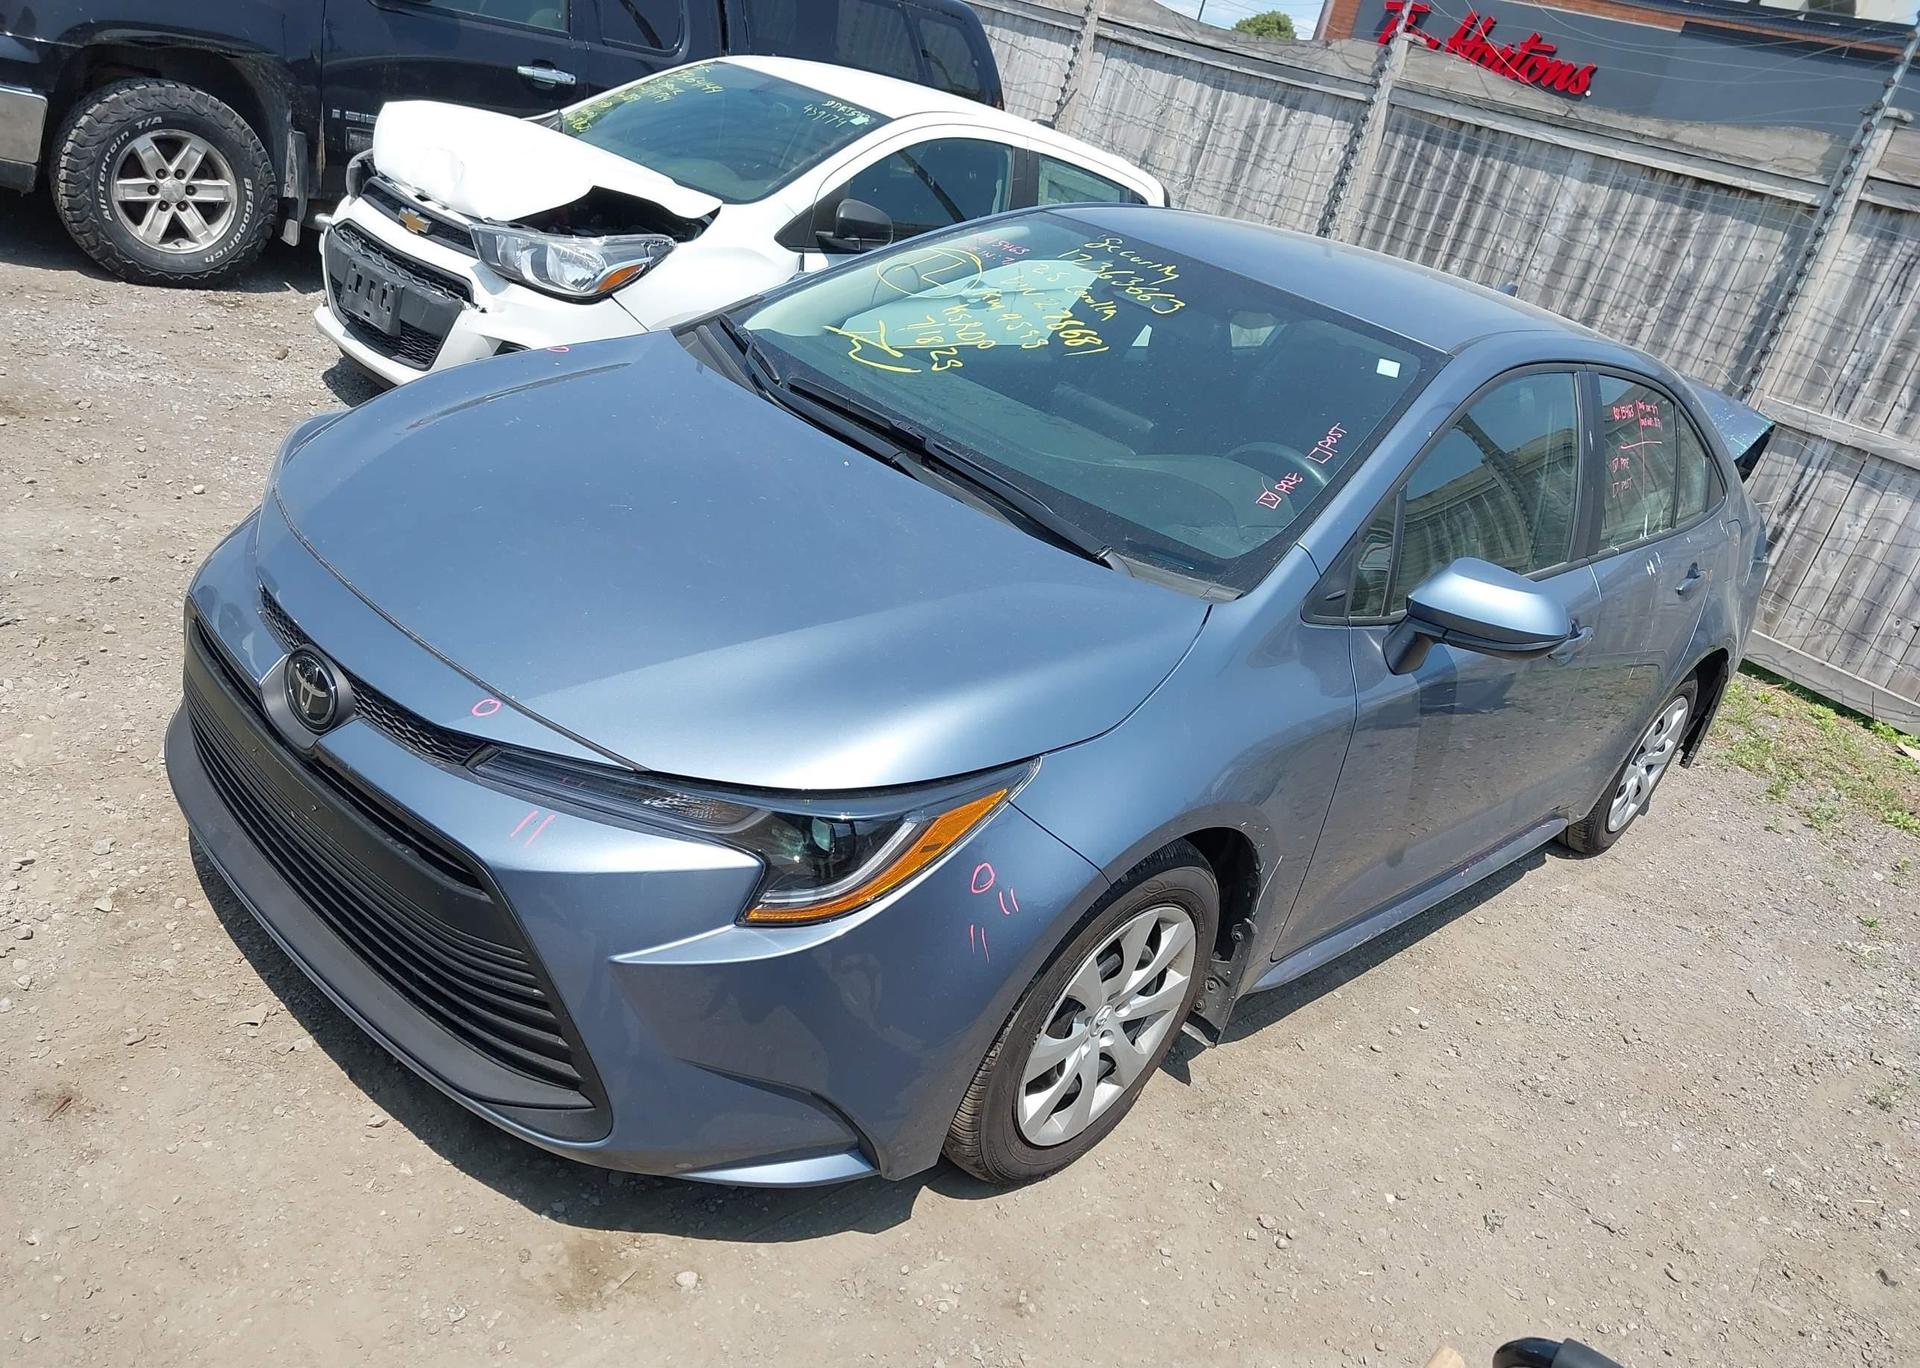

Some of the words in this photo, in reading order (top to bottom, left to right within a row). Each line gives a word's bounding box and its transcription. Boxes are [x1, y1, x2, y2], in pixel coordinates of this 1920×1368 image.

[135, 115, 164, 130] T/A
[1317, 422, 1348, 454] POST
[1274, 472, 1304, 495] PRE
